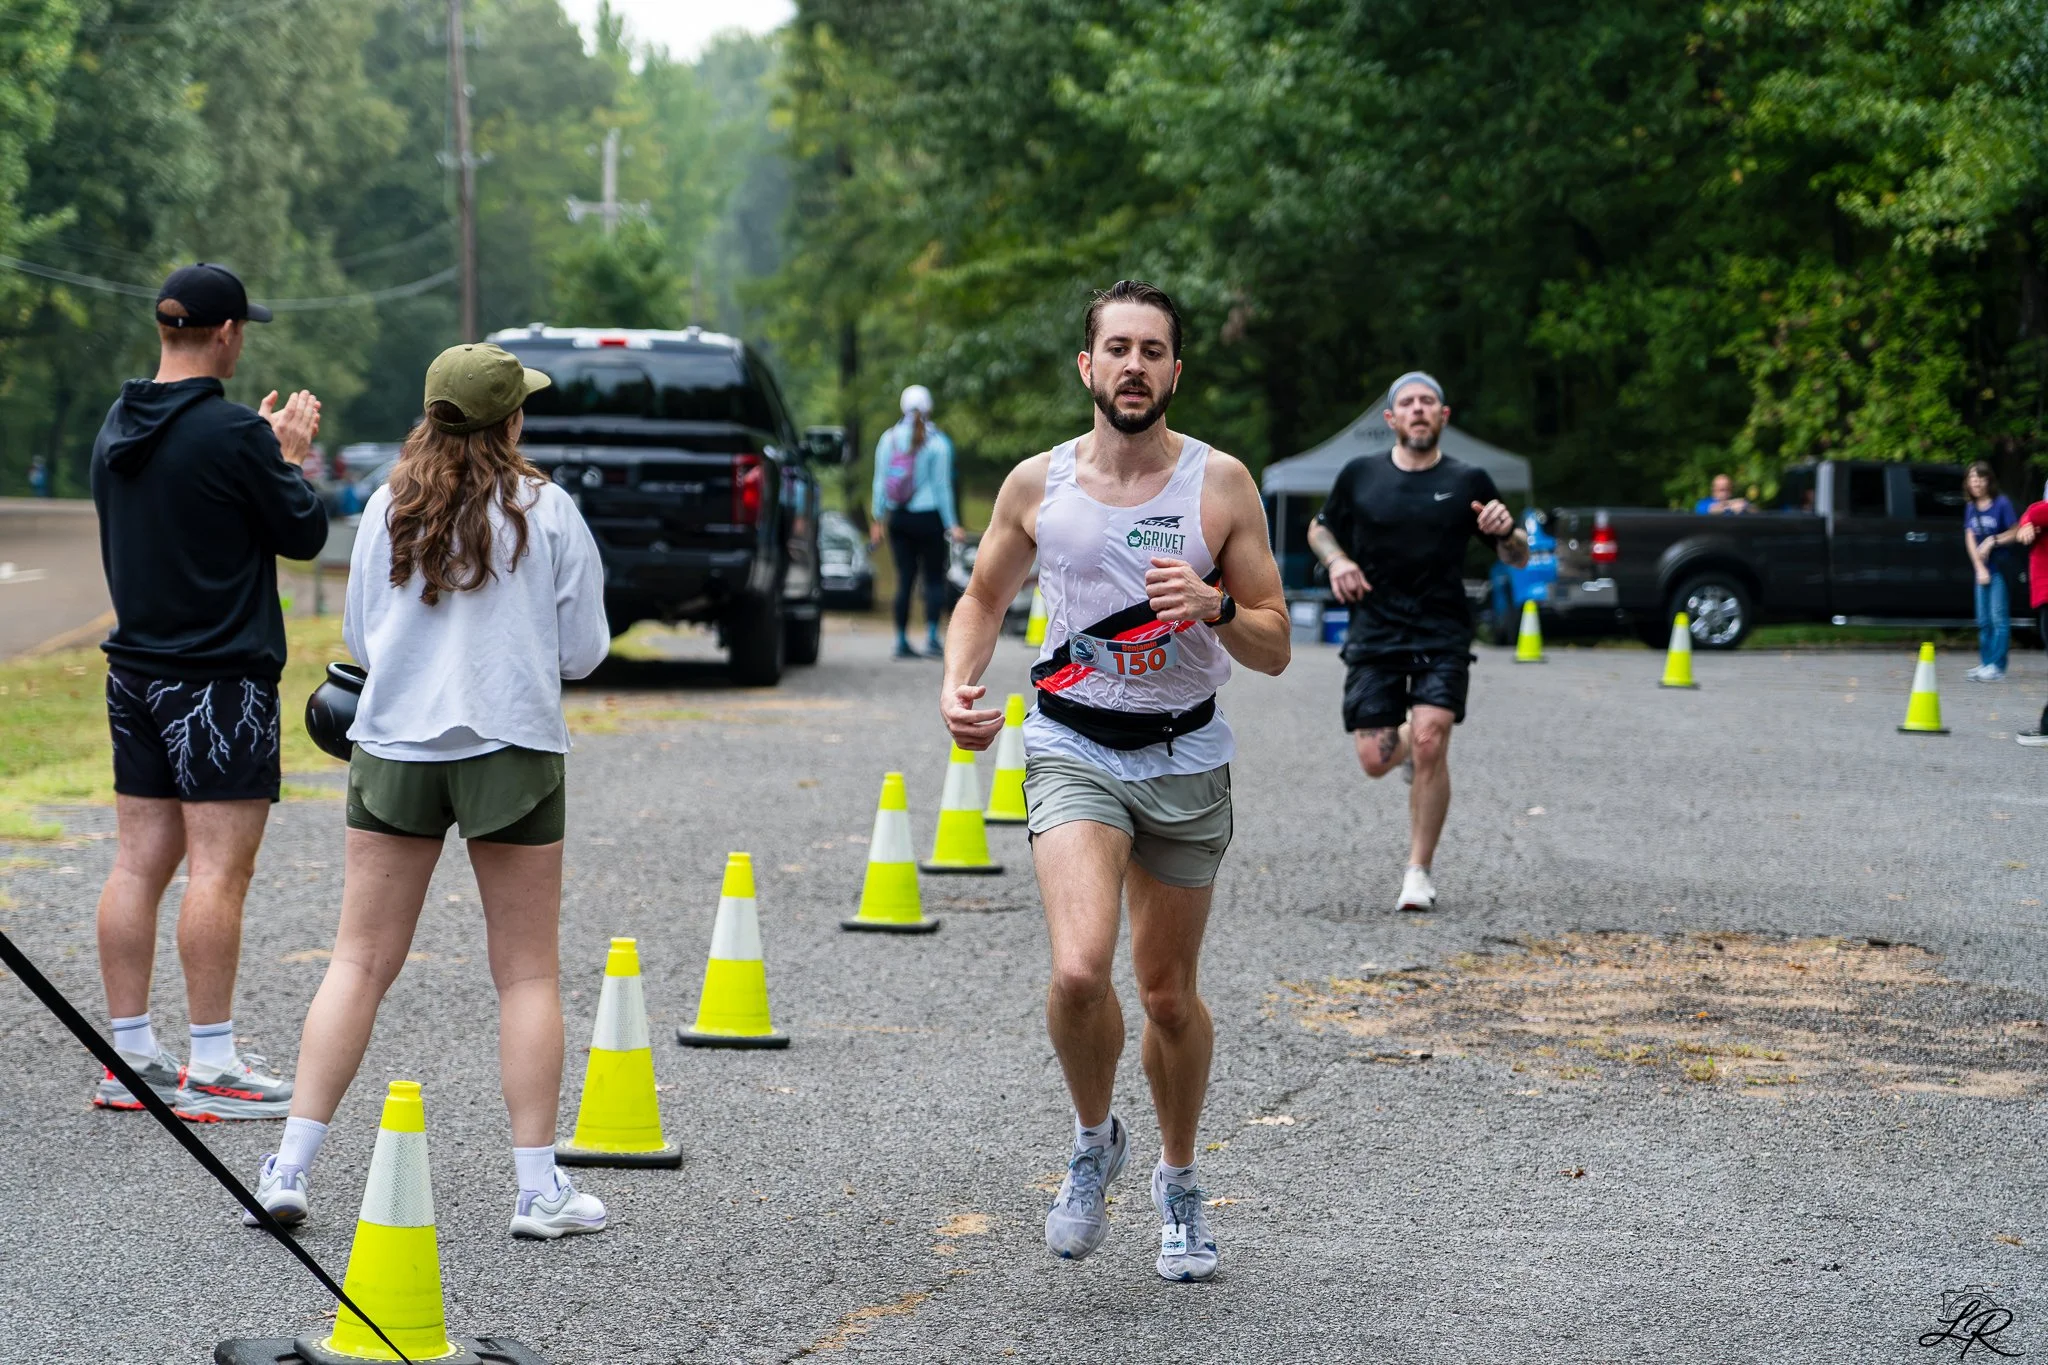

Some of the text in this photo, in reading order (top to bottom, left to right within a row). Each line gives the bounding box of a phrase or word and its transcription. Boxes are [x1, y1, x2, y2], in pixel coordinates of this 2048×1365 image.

[1134, 519, 1180, 529] ALTRA
[1143, 530, 1186, 550] GRIVET
[1142, 546, 1183, 555] OUTDOORS
[1121, 641, 1158, 652] Benjamin
[1112, 647, 1167, 675] 150
[195, 1085, 264, 1101] ALTRA
